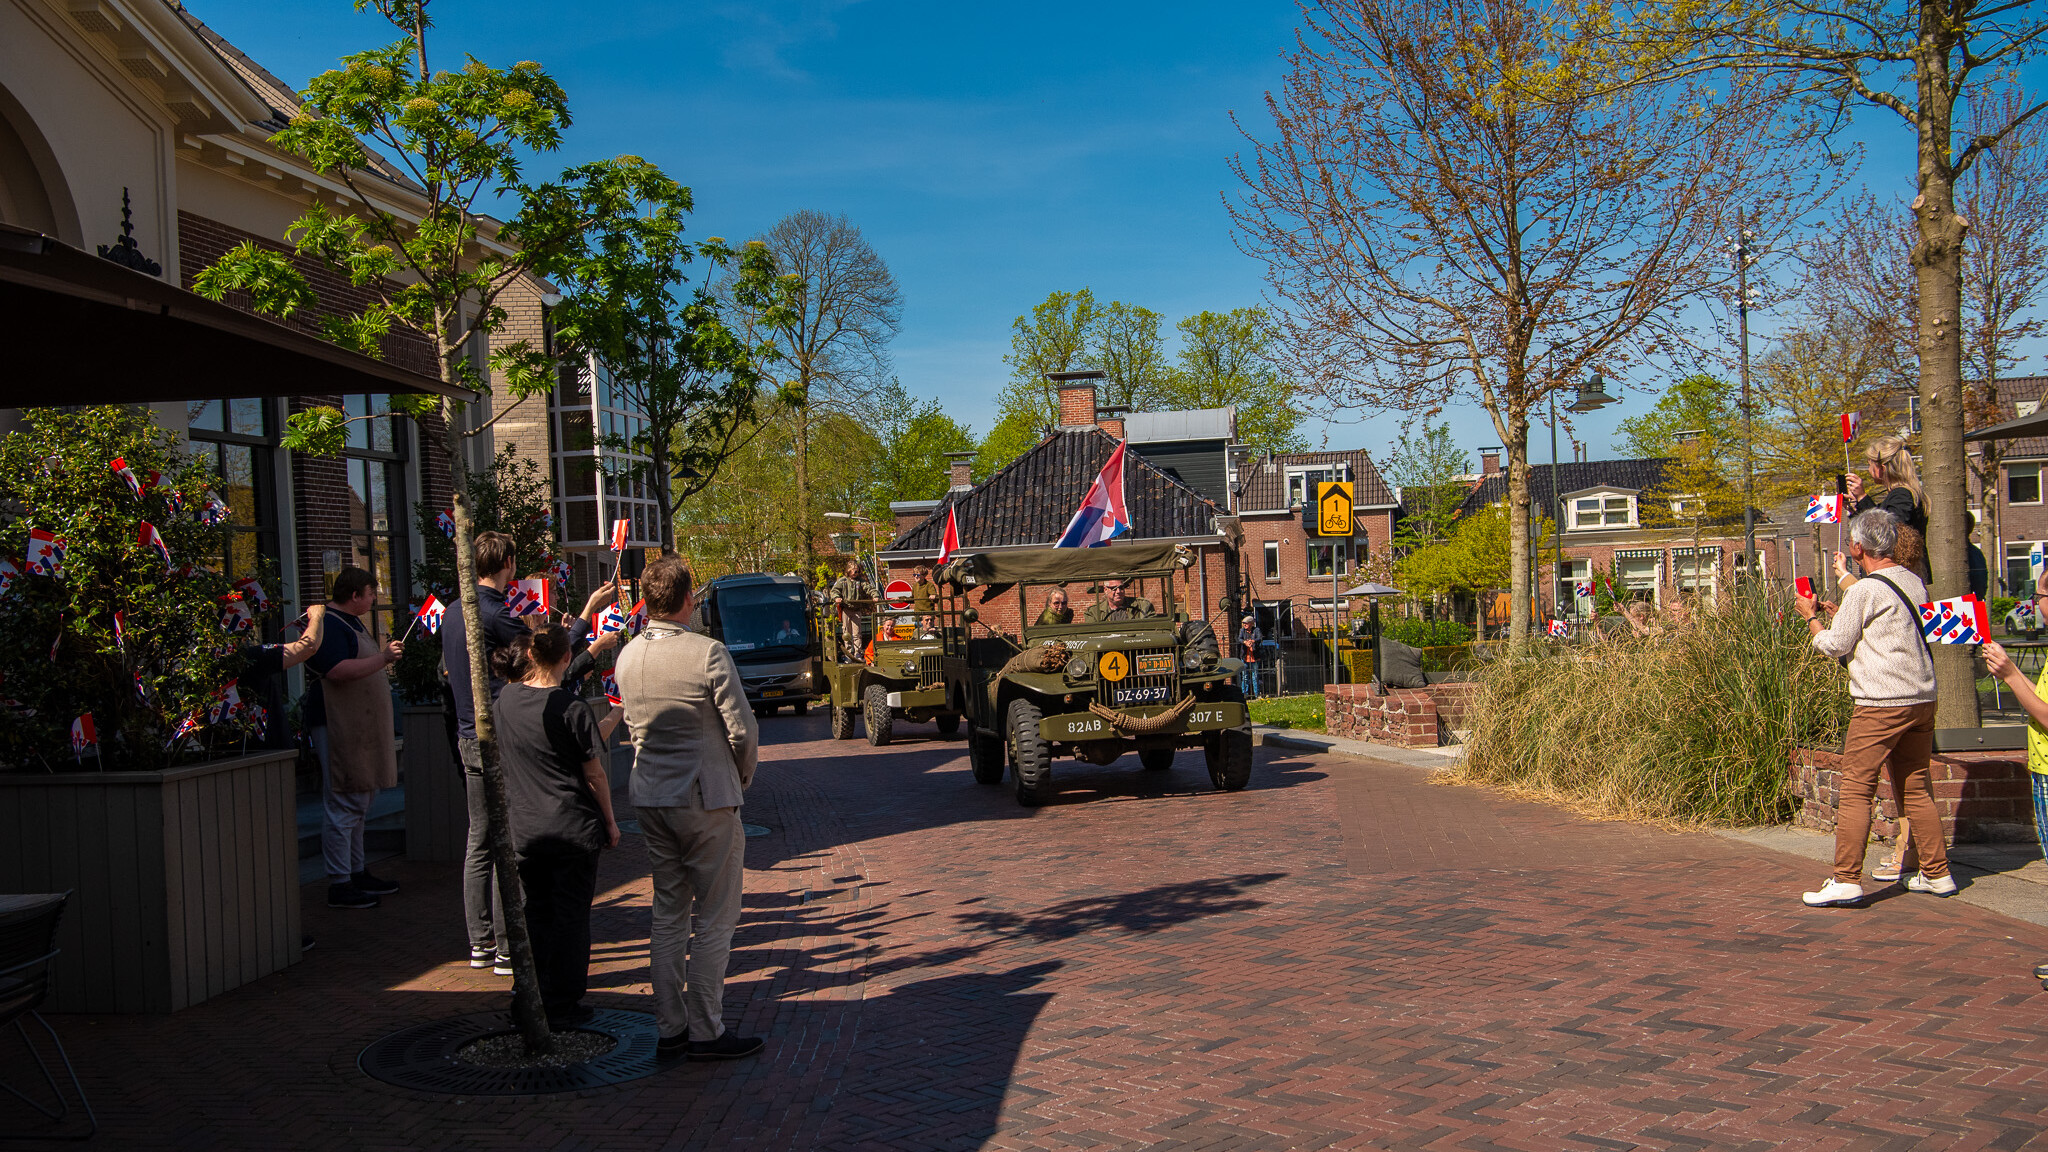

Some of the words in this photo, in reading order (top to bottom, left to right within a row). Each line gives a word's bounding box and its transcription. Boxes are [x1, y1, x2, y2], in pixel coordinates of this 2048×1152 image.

[1334, 500, 1339, 512] 1
[1108, 656, 1121, 676] 4
[1153, 659, 1172, 669] D-DAY
[1117, 688, 1167, 702] DZ-69-37
[1189, 711, 1212, 723] 307
[1216, 710, 1223, 722] E
[1068, 719, 1102, 733] 82AB
